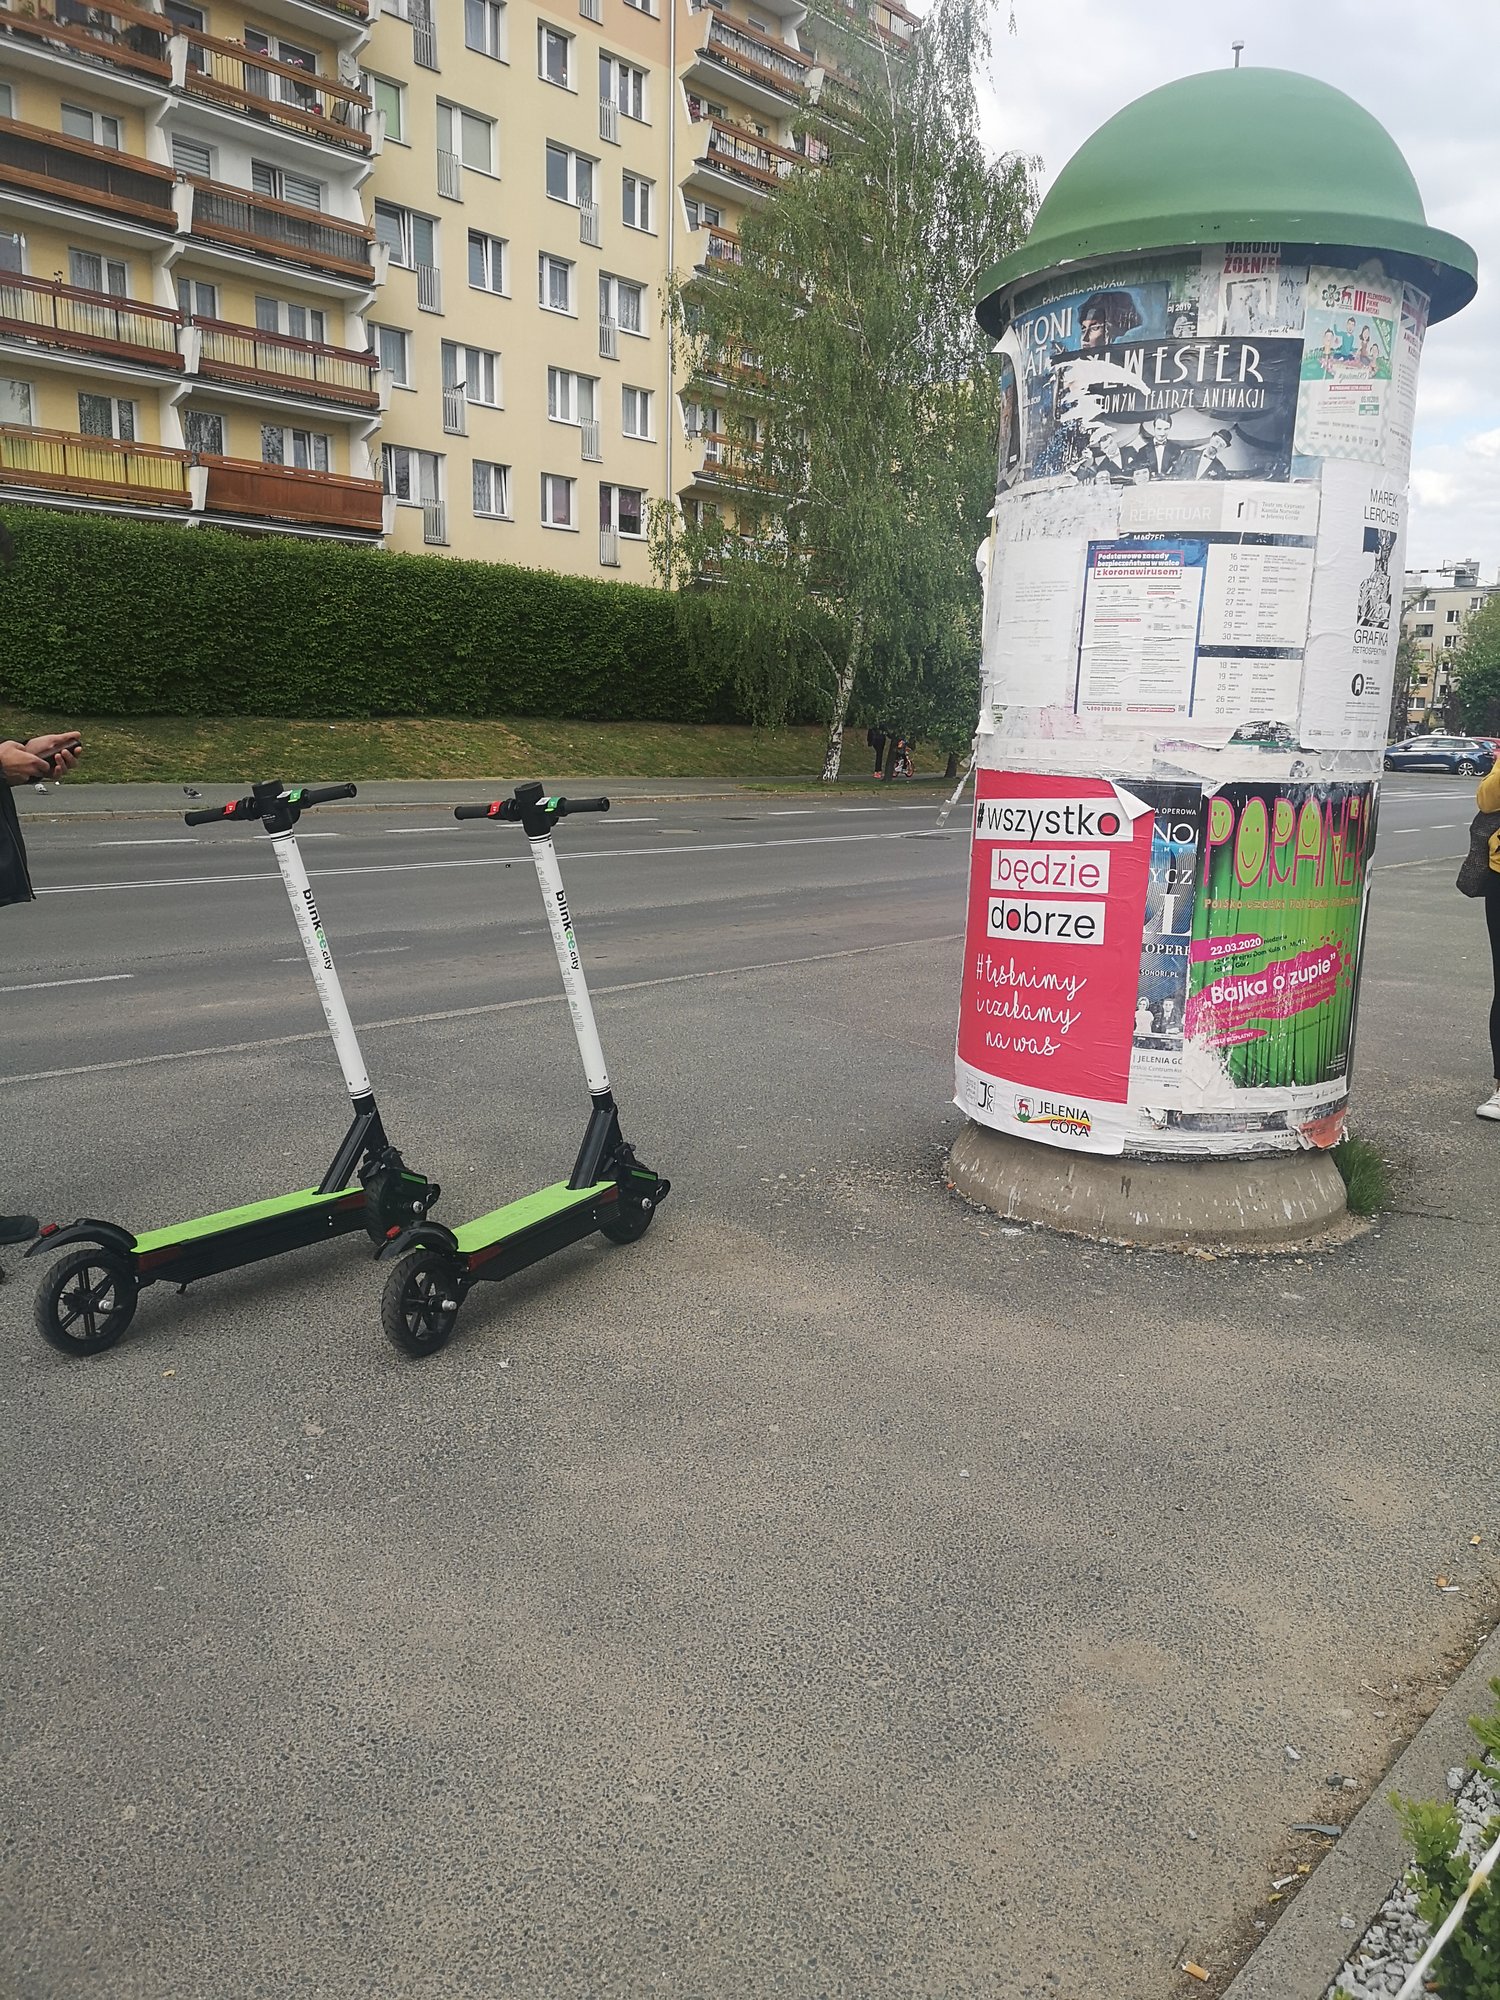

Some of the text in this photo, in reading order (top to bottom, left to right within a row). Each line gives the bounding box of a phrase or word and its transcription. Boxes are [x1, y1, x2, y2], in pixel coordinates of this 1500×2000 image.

[1175, 302, 1192, 312] 2019
[1144, 388, 1195, 410] TEATRZE
[1202, 388, 1265, 408] ANIMACJI
[1370, 488, 1399, 508] MAREK
[1129, 507, 1211, 522] REPERTUAR
[1364, 505, 1400, 527] LERCHER
[1142, 552, 1169, 561] zasady
[1228, 564, 1238, 572] 20
[1161, 807, 1197, 815] OPEROWA
[976, 803, 1121, 843] #wszystko
[1203, 793, 1371, 888] PORANEK
[998, 850, 1100, 889] będzie
[991, 900, 1096, 939] dobrze
[1210, 937, 1262, 956] 22.03.2020
[1273, 975, 1285, 990] o
[976, 990, 1082, 1034] i czekamy
[986, 1031, 1061, 1056] na was
[1138, 1055, 1170, 1065] JELENIA
[1038, 1100, 1090, 1122] JELENIA
[1050, 1117, 1090, 1137] GÓRA
